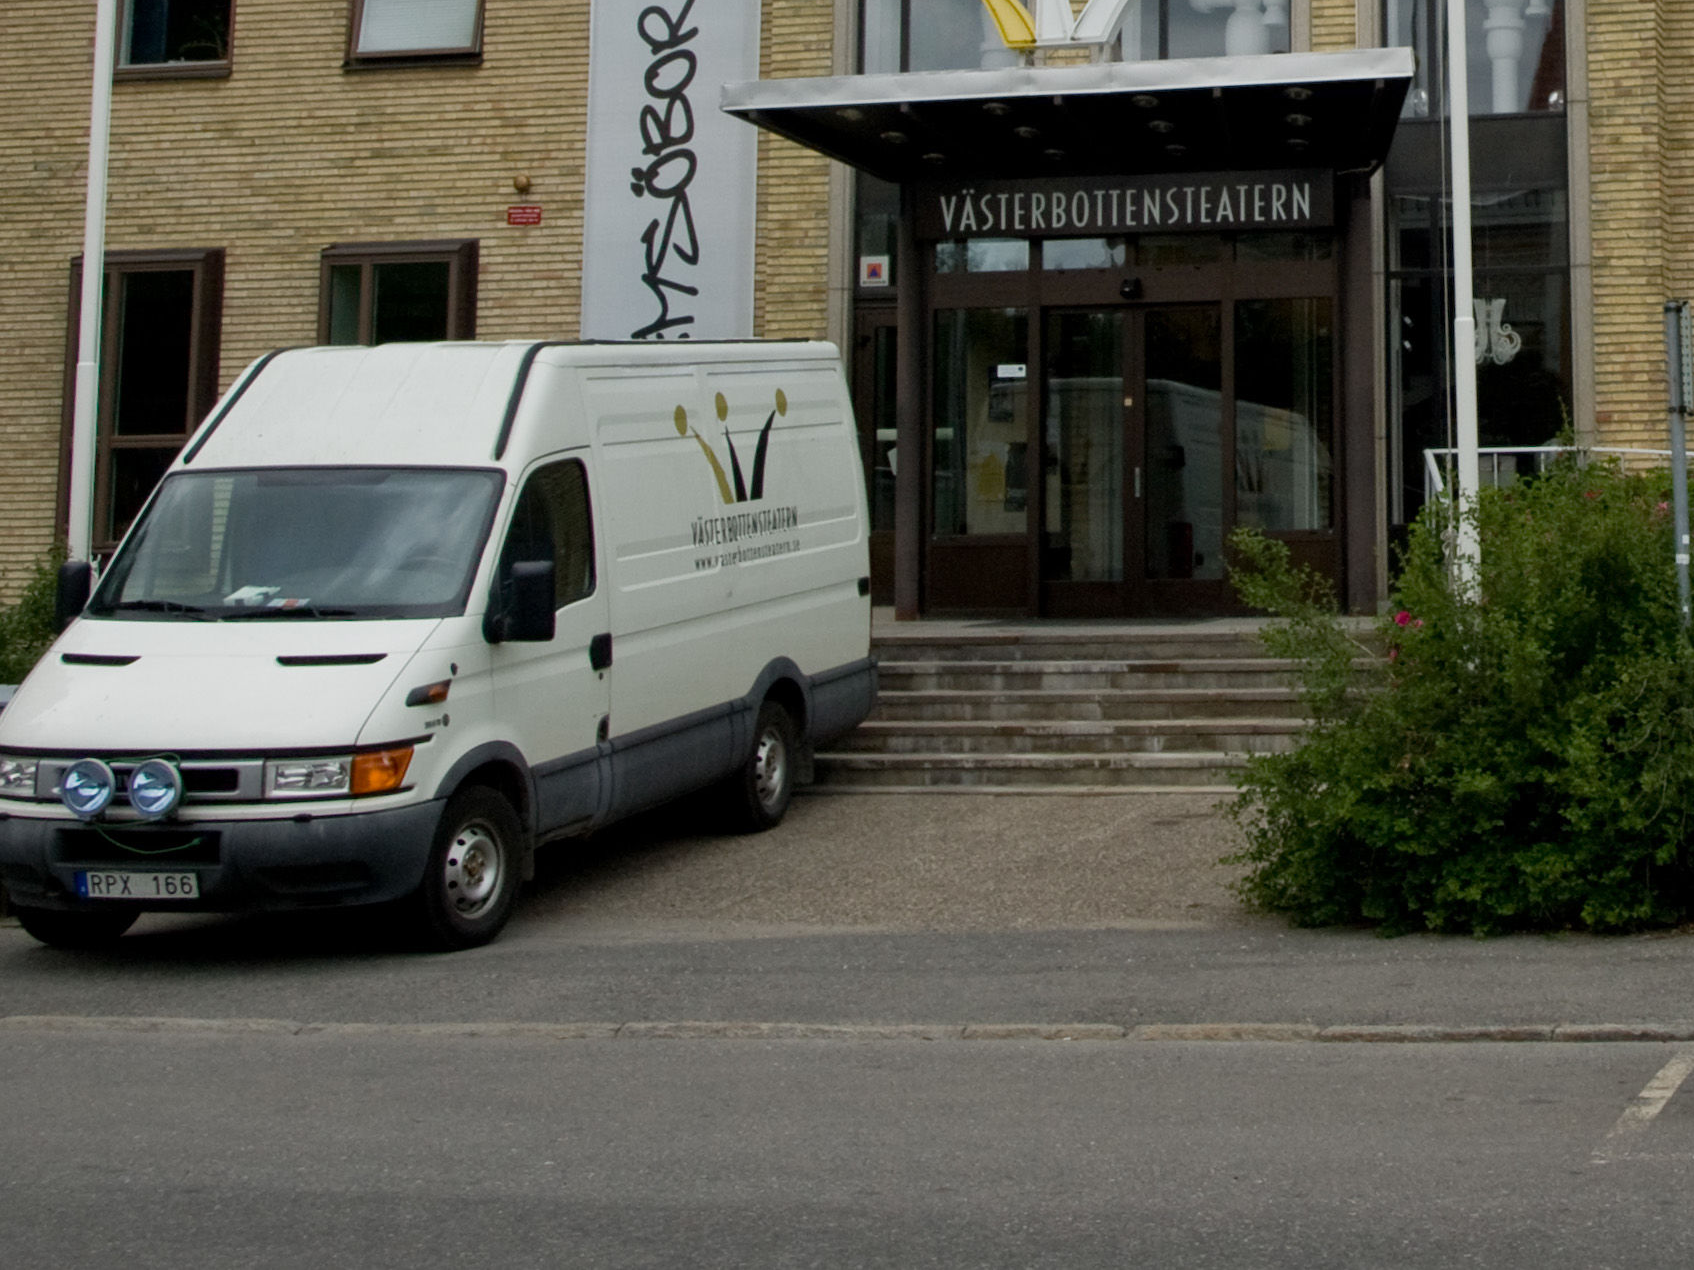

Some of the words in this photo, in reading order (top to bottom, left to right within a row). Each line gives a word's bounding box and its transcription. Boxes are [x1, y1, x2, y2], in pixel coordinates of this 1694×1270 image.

[940, 183, 1310, 232] VÄSTERBOTTENSTEATERN
[691, 506, 798, 546] VÄSTERBOTTENSTEATERN
[90, 874, 132, 895] RPX
[152, 875, 193, 895] 166
